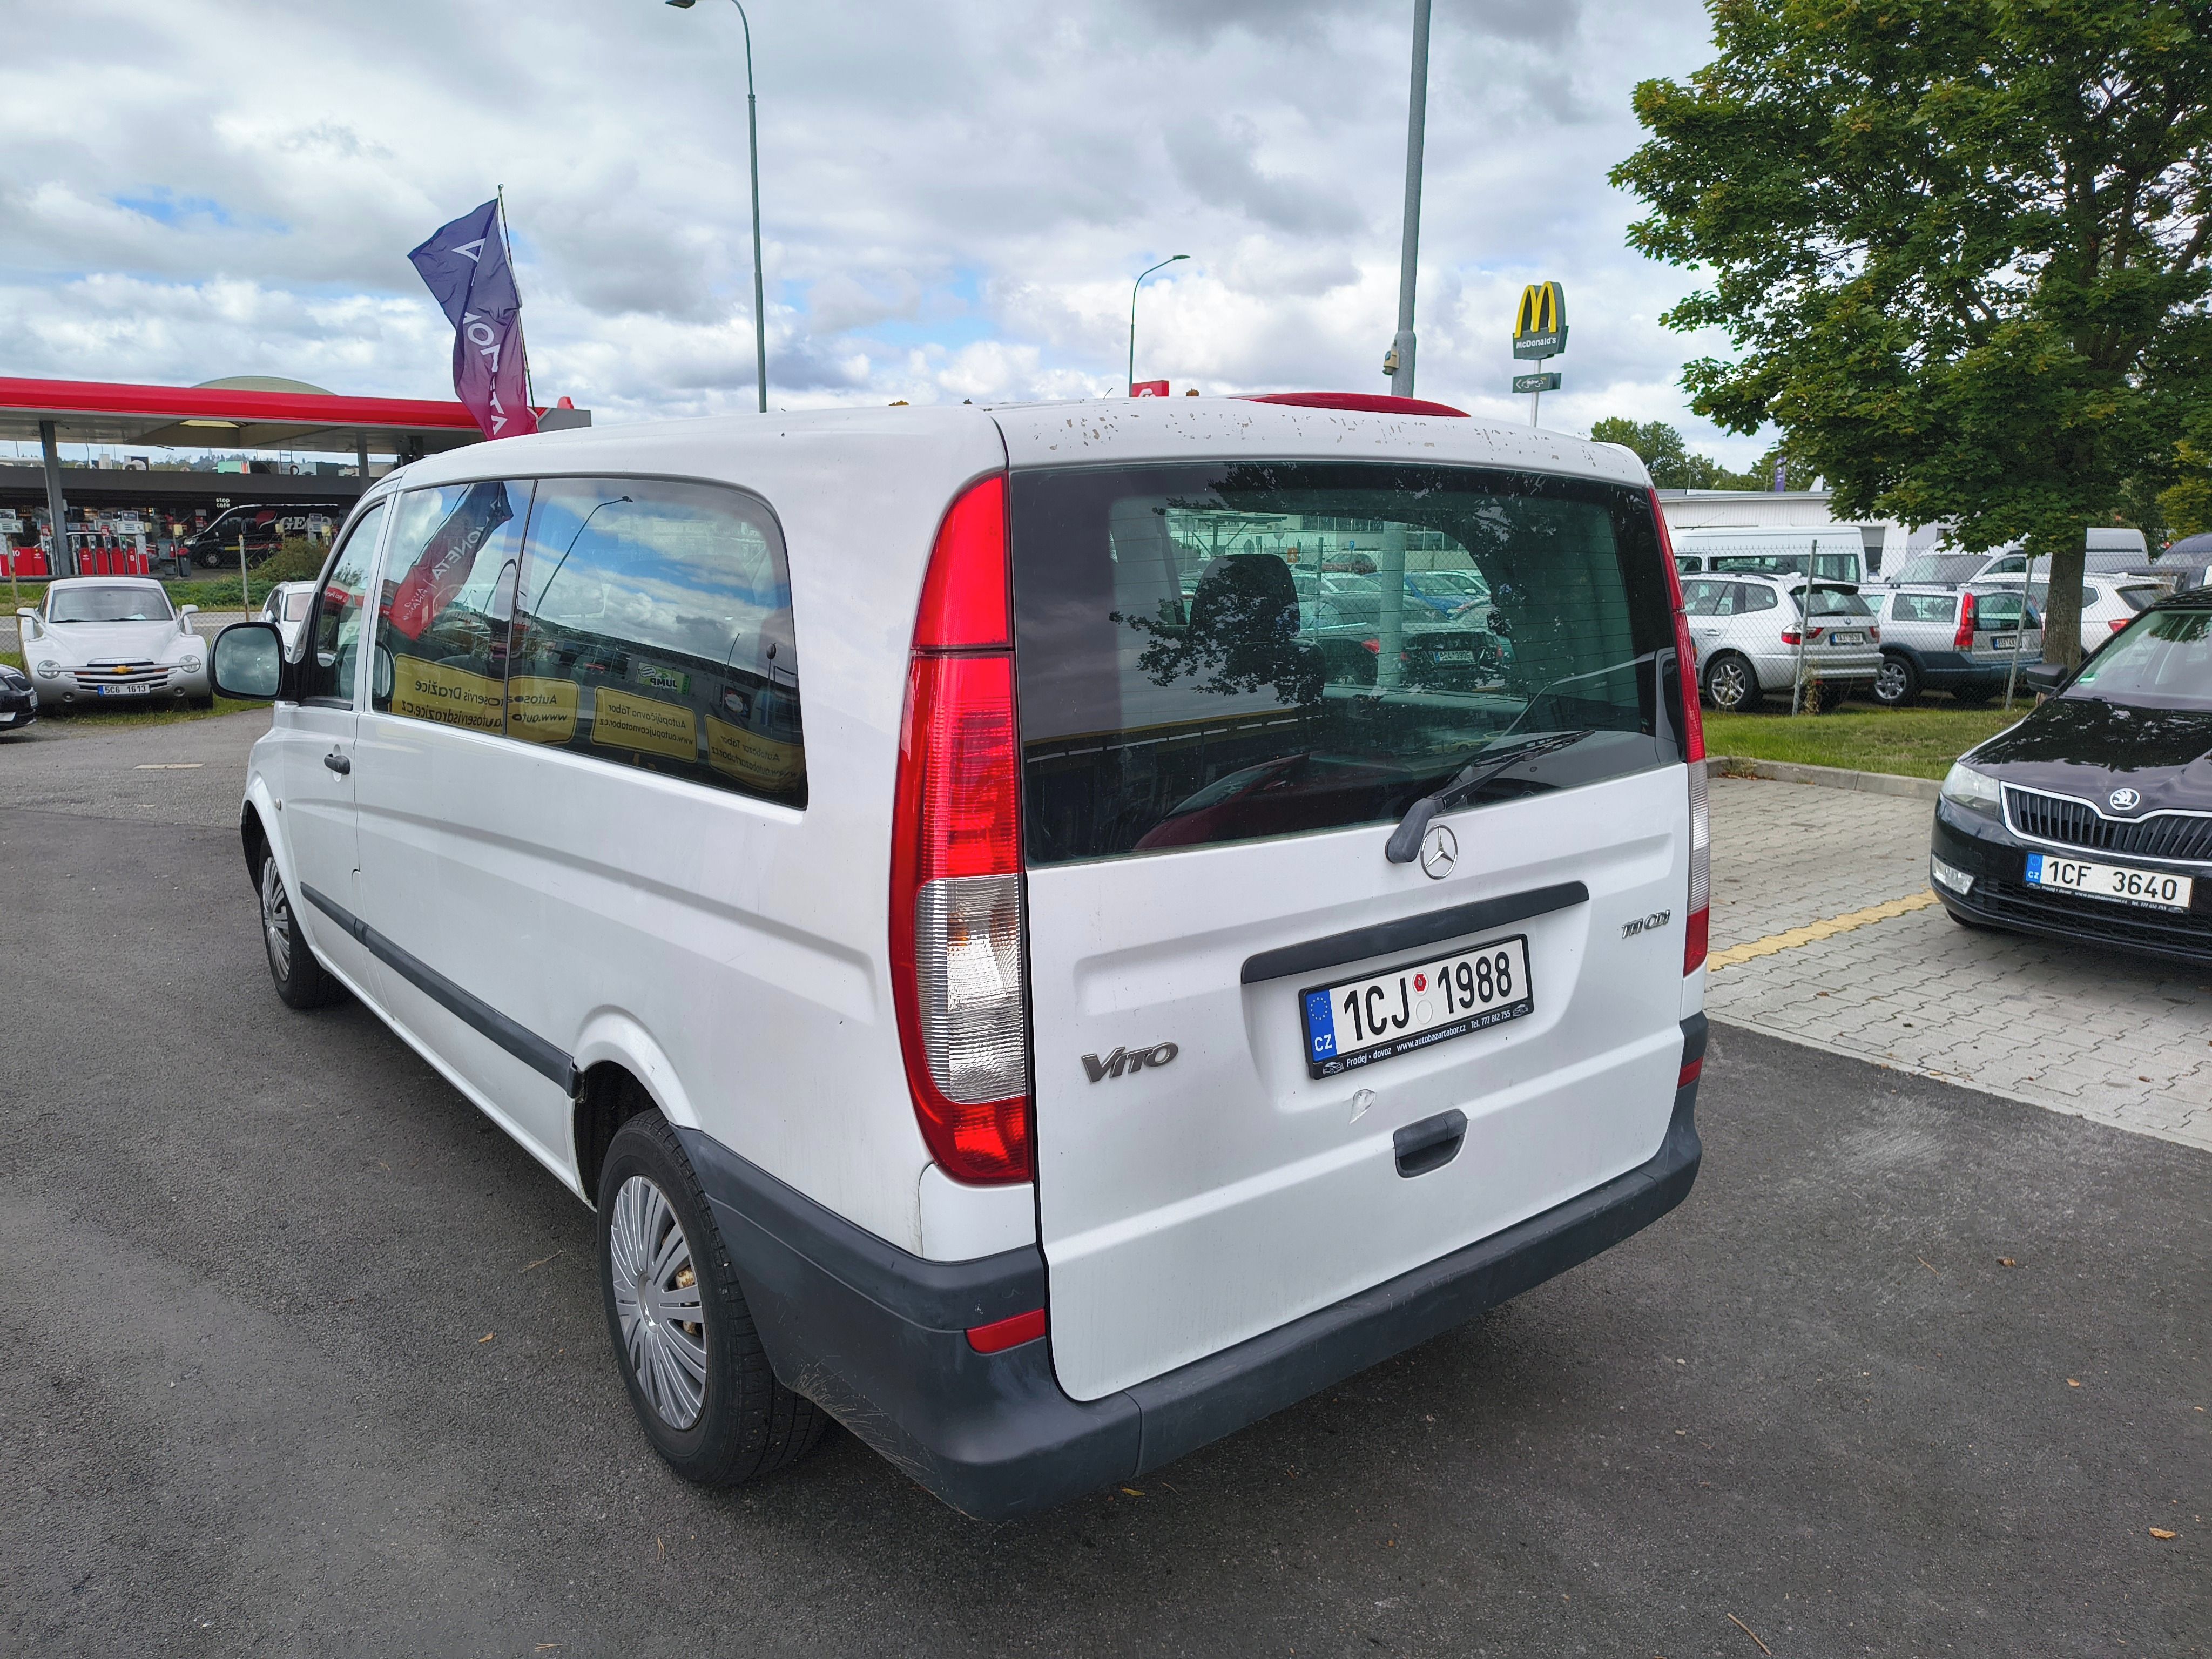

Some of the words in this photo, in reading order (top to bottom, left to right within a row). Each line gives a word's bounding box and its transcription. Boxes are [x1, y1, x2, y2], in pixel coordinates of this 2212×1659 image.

[1515, 336, 1556, 349] McDonald's
[280, 516, 332, 530] GEO
[2028, 871, 2039, 879] CZ
[2049, 861, 2092, 886] 1CF
[2112, 871, 2177, 900] 3640
[1644, 909, 1671, 930] CDI
[1314, 1034, 1333, 1052] CZ
[1343, 977, 1410, 1041] 1CJ
[1437, 950, 1512, 1015] 1988
[1346, 1053, 1367, 1068] Prodej
[1373, 1047, 1392, 1059] dovoz
[1397, 1024, 1466, 1052] www.autobazartabor.cz
[1471, 1020, 1480, 1029] Tel.
[1481, 1016, 1490, 1026] 777
[1492, 1013, 1500, 1022] 812
[1501, 1009, 1510, 1020] 755
